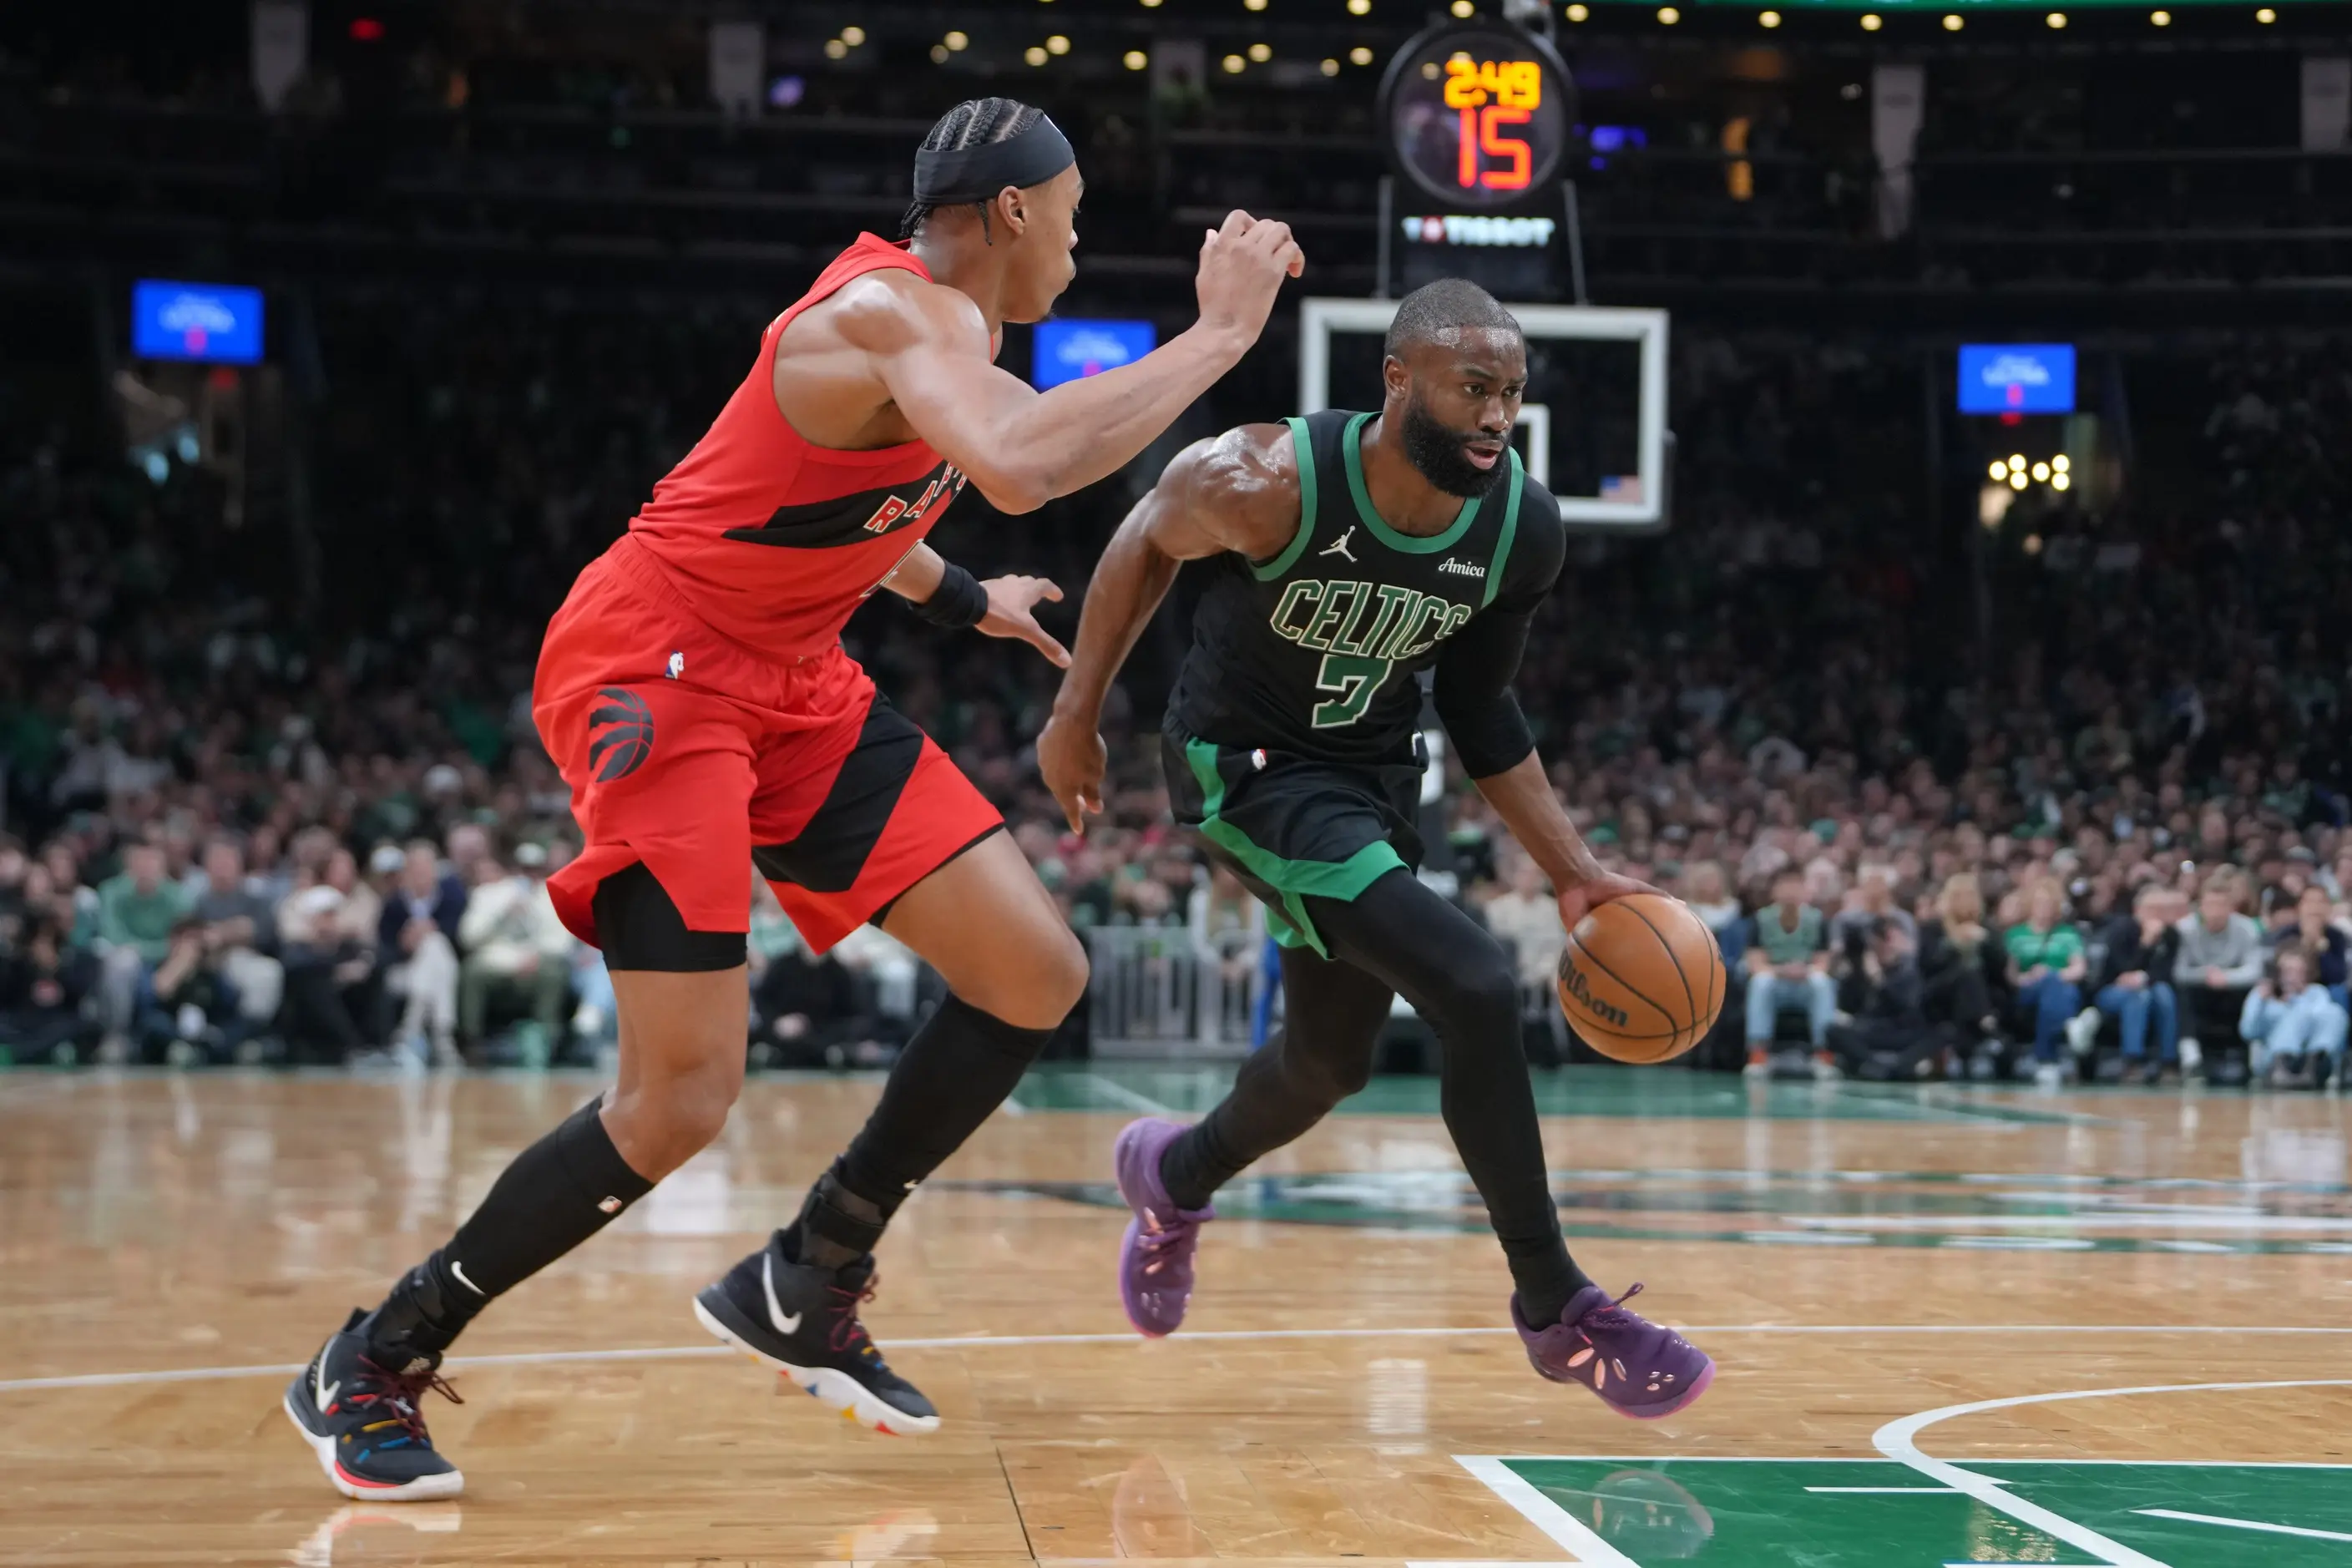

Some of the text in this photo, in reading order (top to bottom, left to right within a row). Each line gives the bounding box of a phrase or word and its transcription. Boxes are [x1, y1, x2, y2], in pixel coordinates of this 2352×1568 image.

[1459, 105, 1531, 189] 15
[1439, 557, 1485, 578] Amica
[1312, 653, 1393, 728] 7
